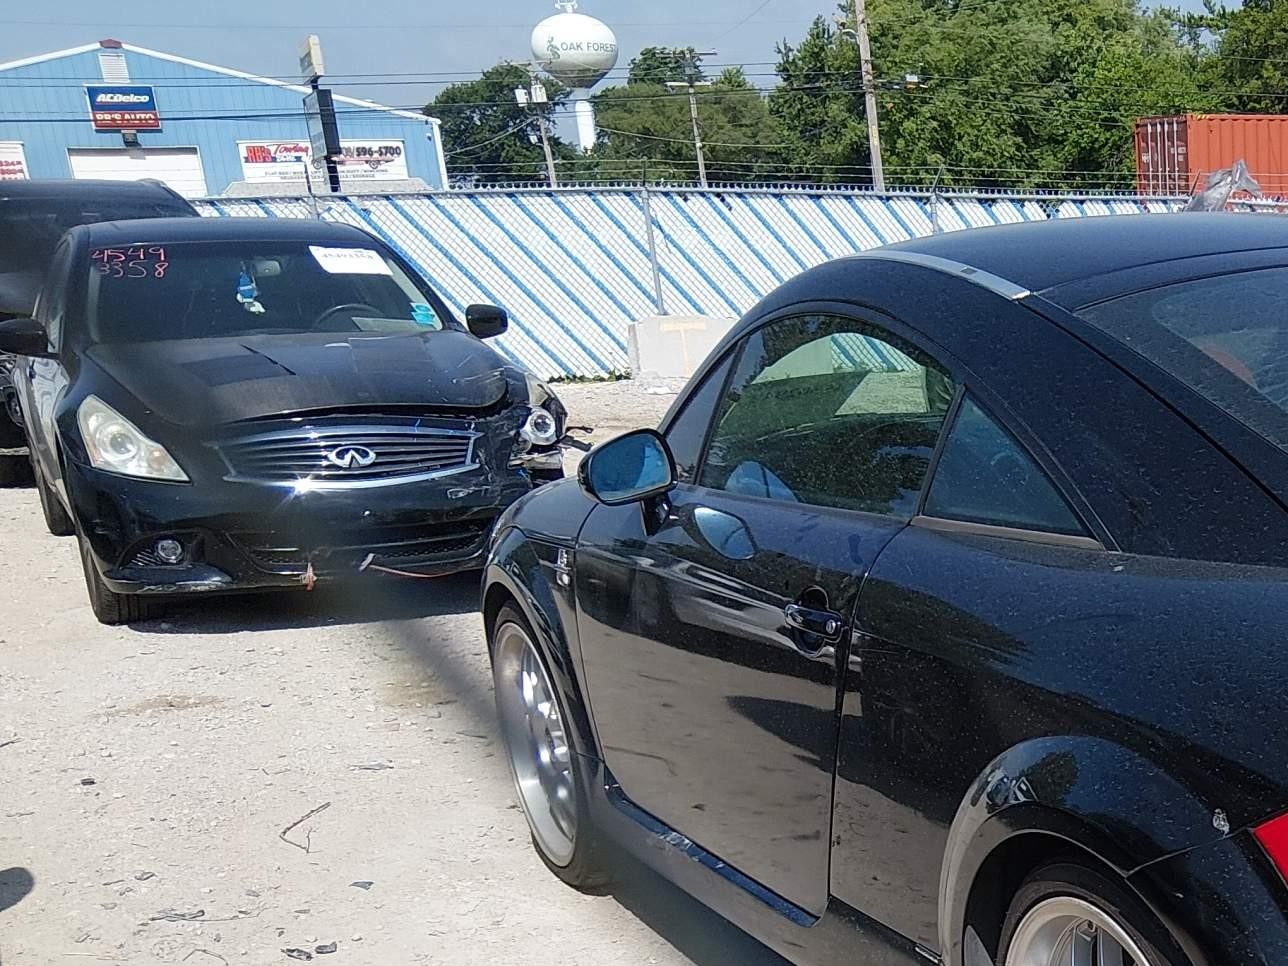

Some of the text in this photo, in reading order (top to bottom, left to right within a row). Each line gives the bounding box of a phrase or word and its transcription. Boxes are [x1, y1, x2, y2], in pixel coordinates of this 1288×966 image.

[560, 41, 583, 51] OAK
[95, 93, 150, 103] ACDelco
[124, 113, 155, 124] AUTO
[92, 246, 165, 262] 4549
[98, 260, 169, 278] 3358
